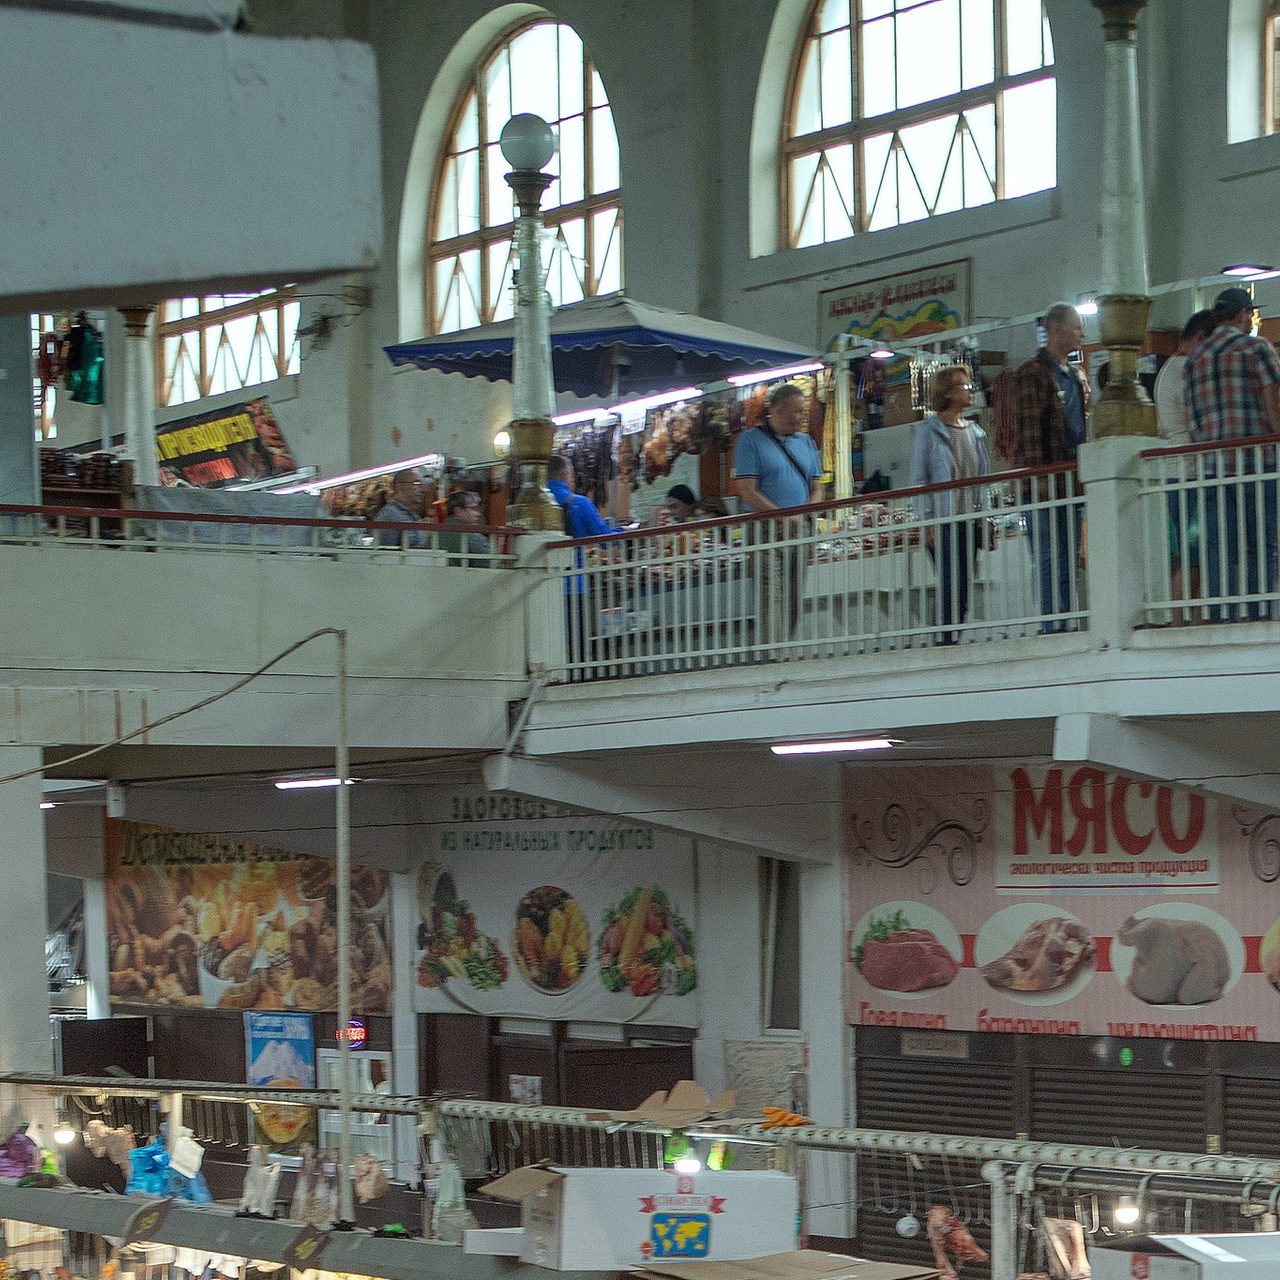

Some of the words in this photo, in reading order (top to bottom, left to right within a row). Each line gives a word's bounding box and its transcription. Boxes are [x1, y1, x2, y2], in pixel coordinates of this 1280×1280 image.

[441, 830, 458, 850] ИЗ
[463, 830, 561, 851] НАТУРАЛЬНЫХ
[567, 828, 655, 852] ПРОДУКТОВ
[1011, 767, 1206, 857] МЯСО
